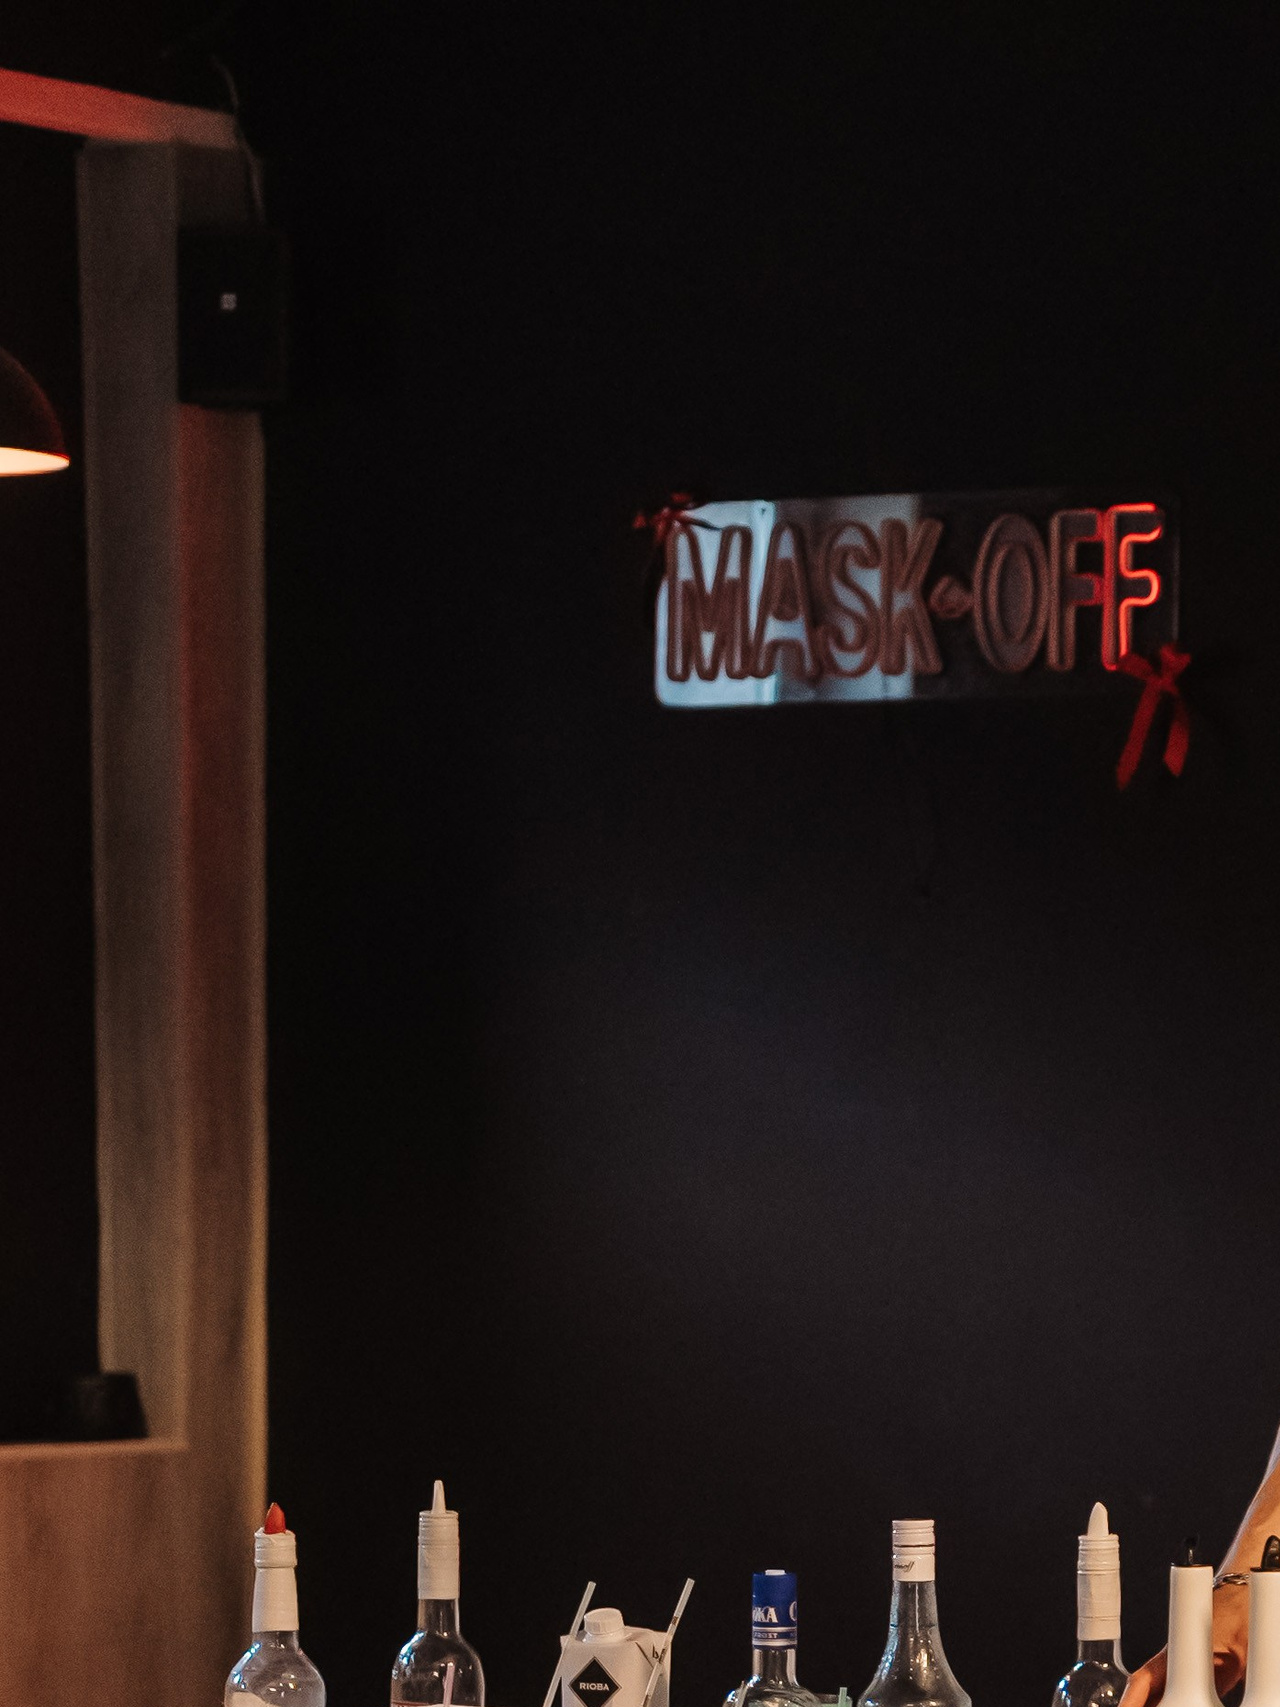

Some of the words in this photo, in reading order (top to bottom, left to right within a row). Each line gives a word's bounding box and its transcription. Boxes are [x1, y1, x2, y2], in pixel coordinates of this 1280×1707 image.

[665, 517, 944, 683] MASK
[972, 502, 1162, 673] OFF
[579, 1682, 610, 1692] RIOBA
